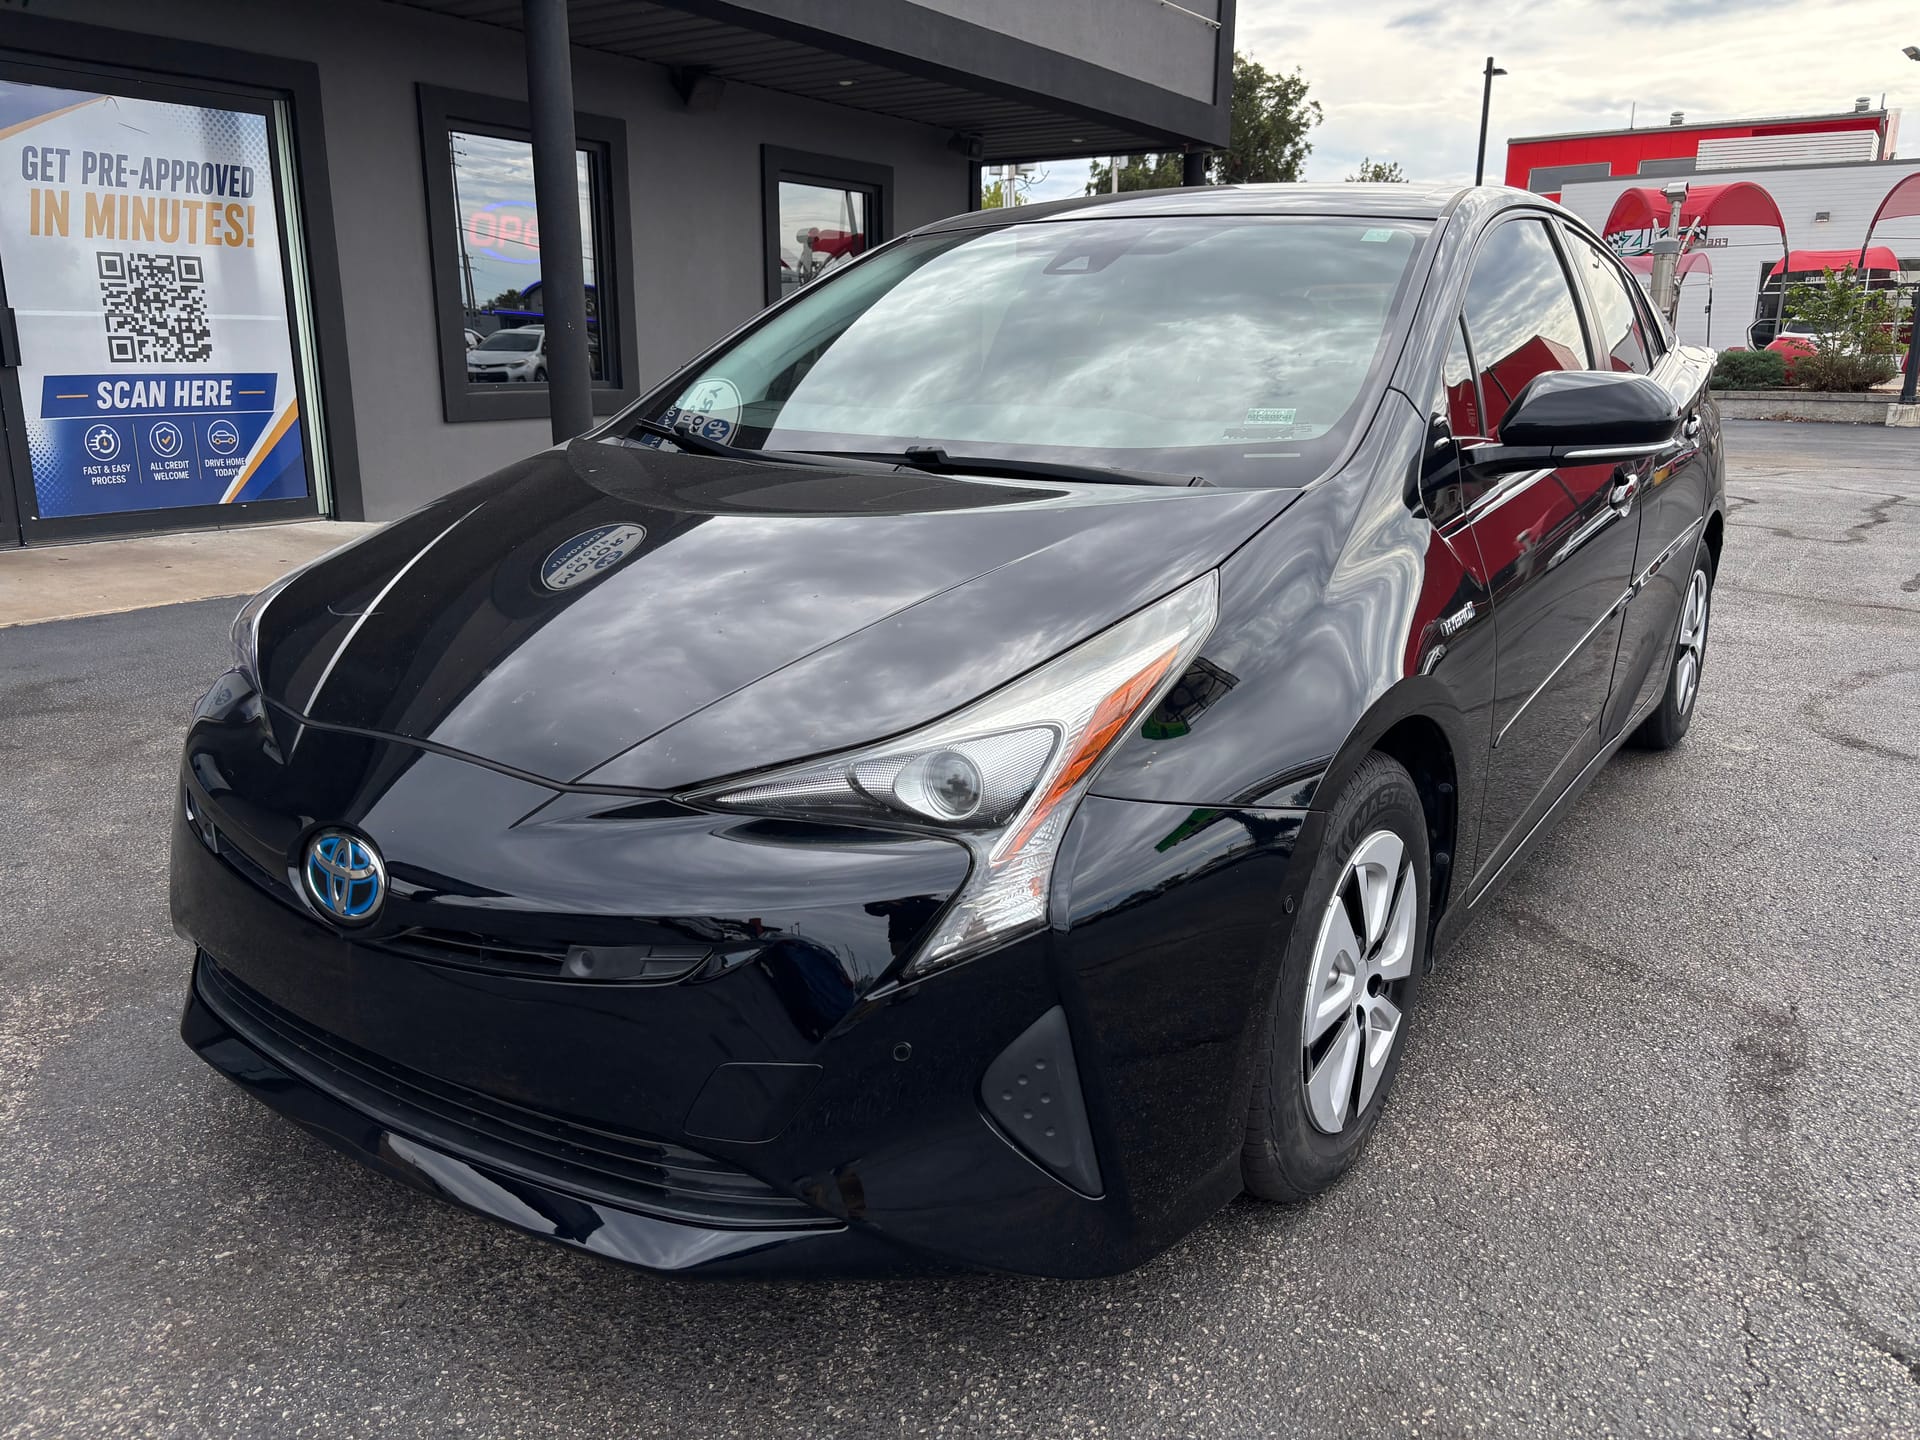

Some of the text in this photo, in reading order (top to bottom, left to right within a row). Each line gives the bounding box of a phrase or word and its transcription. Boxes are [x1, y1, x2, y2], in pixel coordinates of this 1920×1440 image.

[22, 145, 254, 198] GET PRE-APPROVED
[30, 188, 255, 248] IN MINUTES!
[470, 212, 540, 251] OPE
[97, 380, 233, 409] SCAN HERE
[150, 460, 189, 471] ALL CREDIT
[204, 457, 246, 467] DRIVE HOME
[83, 463, 131, 476] FAST & EASY
[153, 471, 190, 481] WELCOME
[91, 474, 127, 486] PROCESS
